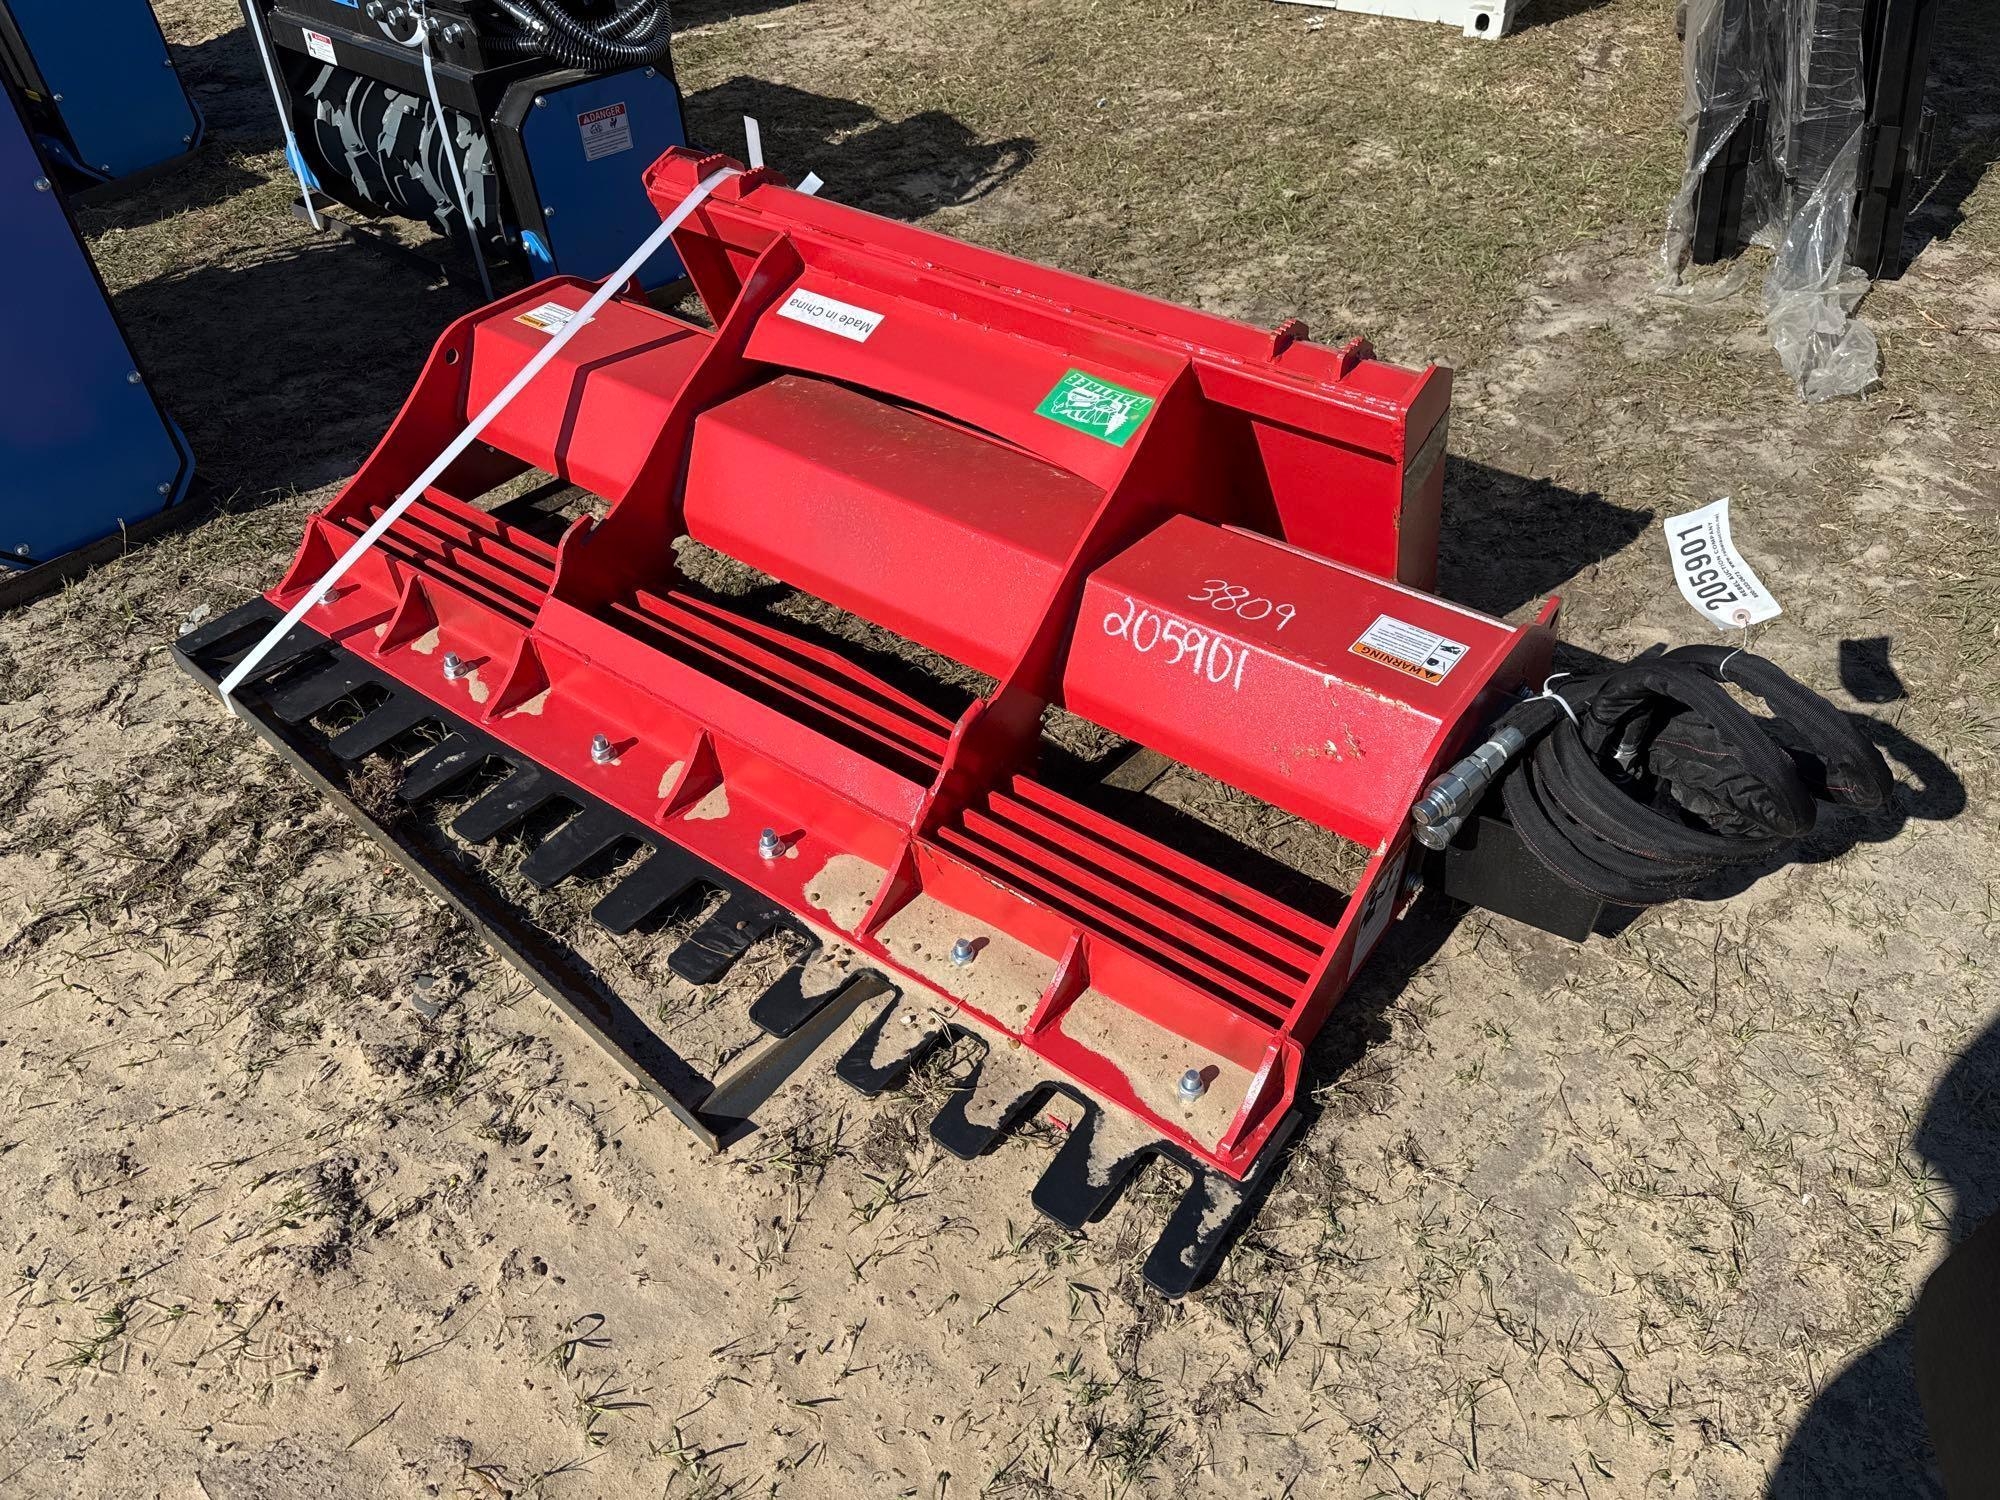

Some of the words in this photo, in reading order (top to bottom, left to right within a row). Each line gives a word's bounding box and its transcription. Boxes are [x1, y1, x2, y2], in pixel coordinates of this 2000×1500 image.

[590, 106, 621, 122] DANGER
[789, 298, 824, 317] China
[826, 310, 838, 320] in
[839, 315, 873, 333] Made
[1707, 522, 1719, 555] COMPANY
[1677, 524, 1739, 611] 205901
[1716, 555, 1734, 581] AUCTION
[1732, 580, 1748, 598] REBEL
[1188, 579, 1296, 631] 3809
[1103, 594, 1249, 691] 205901
[1361, 646, 1421, 675] WARNING
